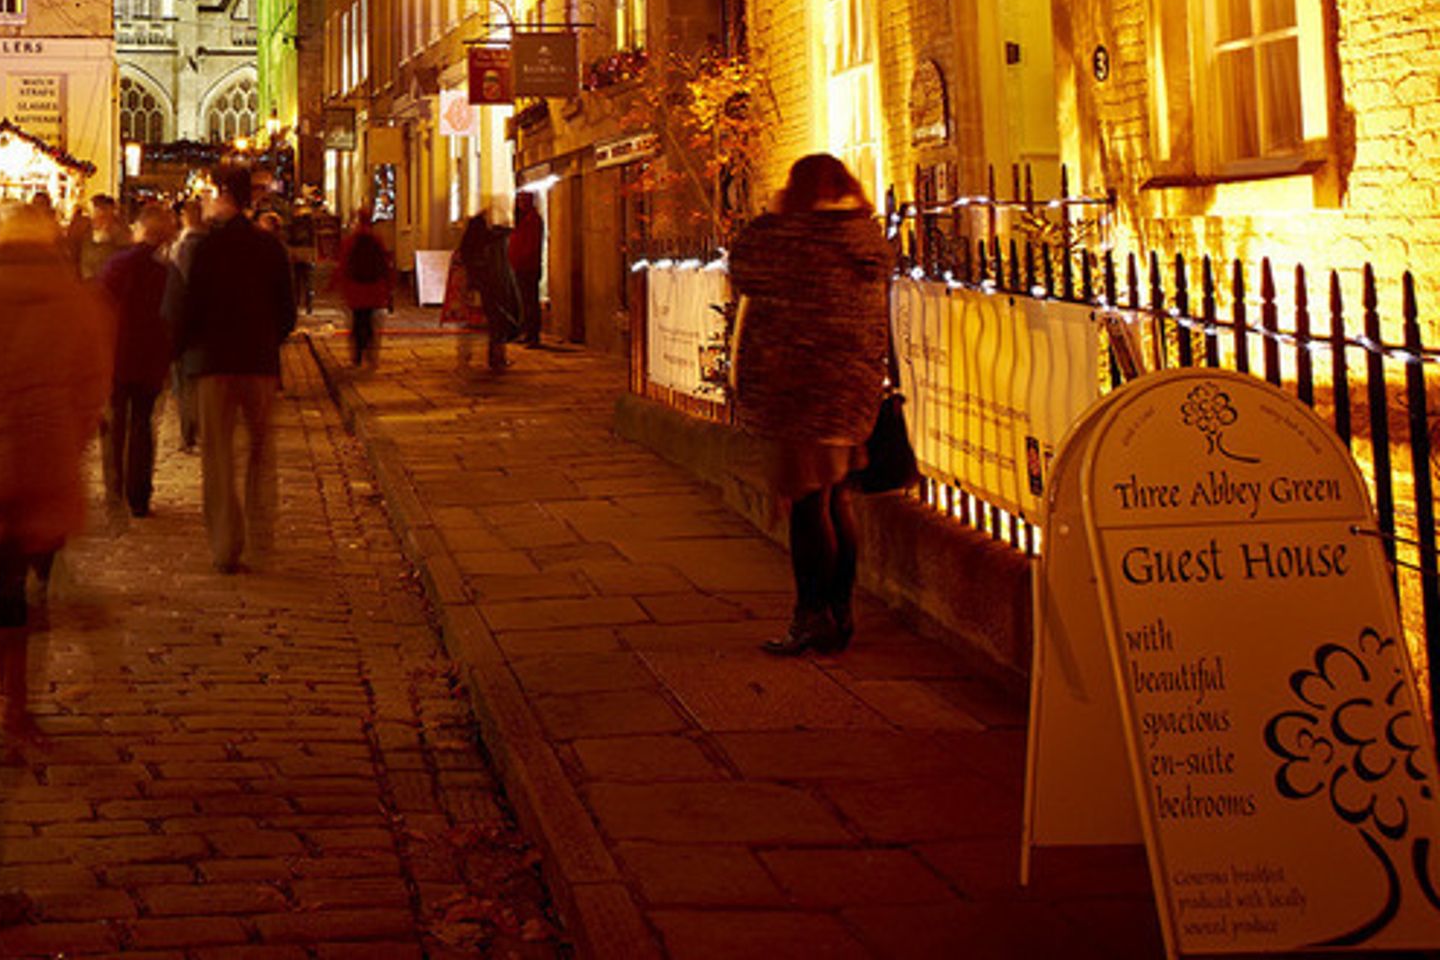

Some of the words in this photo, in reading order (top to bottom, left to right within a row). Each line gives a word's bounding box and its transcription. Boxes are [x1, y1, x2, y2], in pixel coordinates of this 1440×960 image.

[1096, 51, 1107, 80] 3
[1113, 474, 1181, 509] Three
[1190, 471, 1261, 518] Abbey
[1269, 477, 1341, 504] Green
[1122, 539, 1223, 585] Guest
[1240, 543, 1349, 579] House
[1126, 617, 1173, 651] with
[1131, 656, 1225, 705] beautiful
[1143, 706, 1230, 748] spacious
[1151, 746, 1234, 777] en-suite
[1156, 784, 1256, 819] bedrooms
